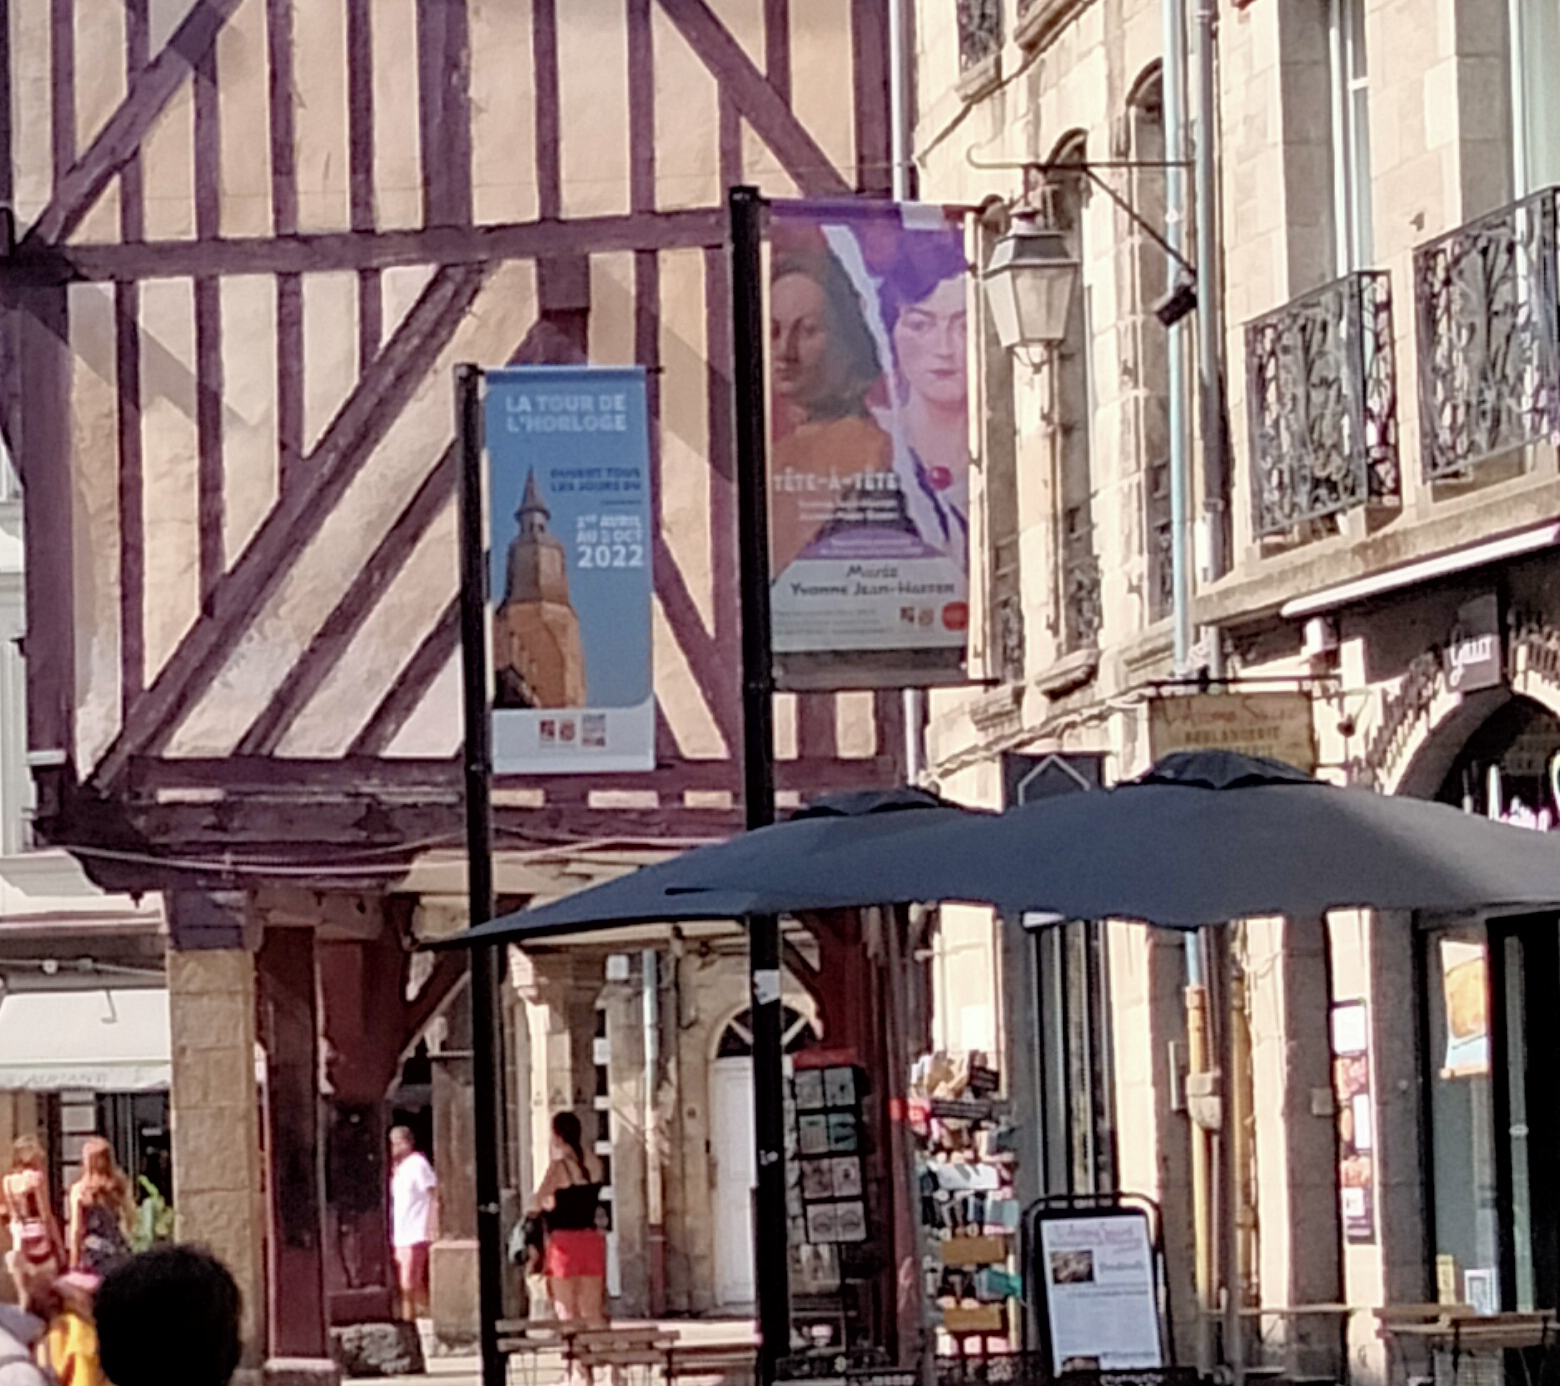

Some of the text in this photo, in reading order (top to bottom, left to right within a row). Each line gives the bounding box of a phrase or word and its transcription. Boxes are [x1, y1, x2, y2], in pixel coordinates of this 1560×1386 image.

[505, 393, 627, 413] LA TOUR DE
[506, 414, 627, 433] L'HORLOGE
[551, 481, 574, 492] LES
[600, 515, 641, 528] AVRIL
[576, 530, 598, 544] AU
[613, 529, 644, 544] OCT
[577, 545, 644, 569] 2022
